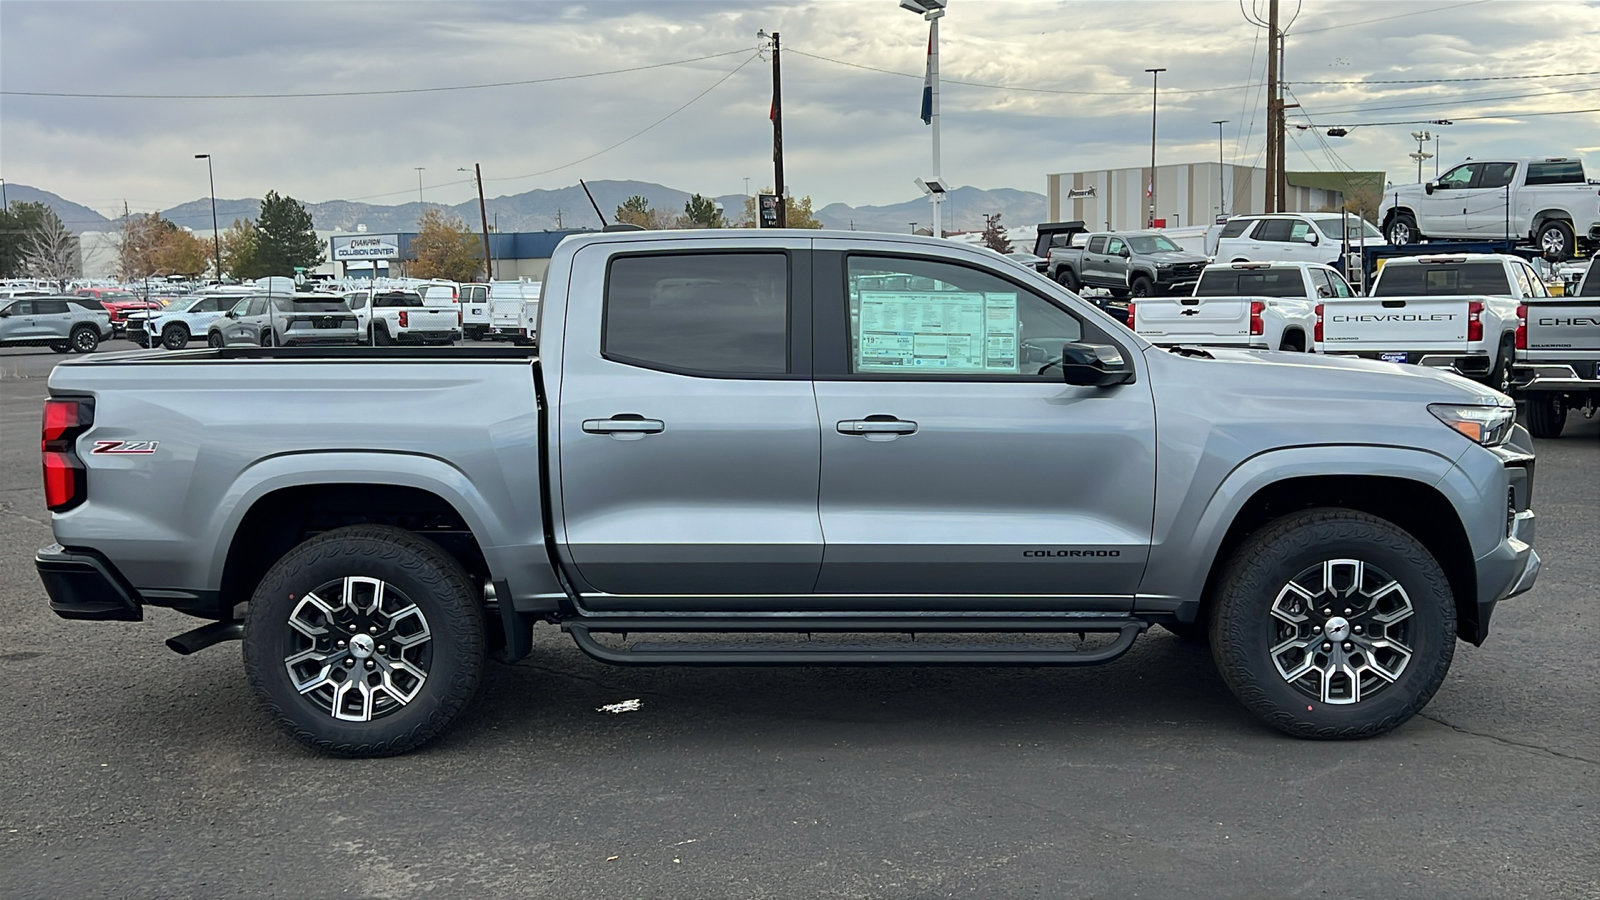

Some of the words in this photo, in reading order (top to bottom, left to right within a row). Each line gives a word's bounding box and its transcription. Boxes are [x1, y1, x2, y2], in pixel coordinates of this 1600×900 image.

[338, 248, 369, 256] COLLISION
[1333, 314, 1457, 322] CHEVROLET
[89, 440, 160, 455] Z71
